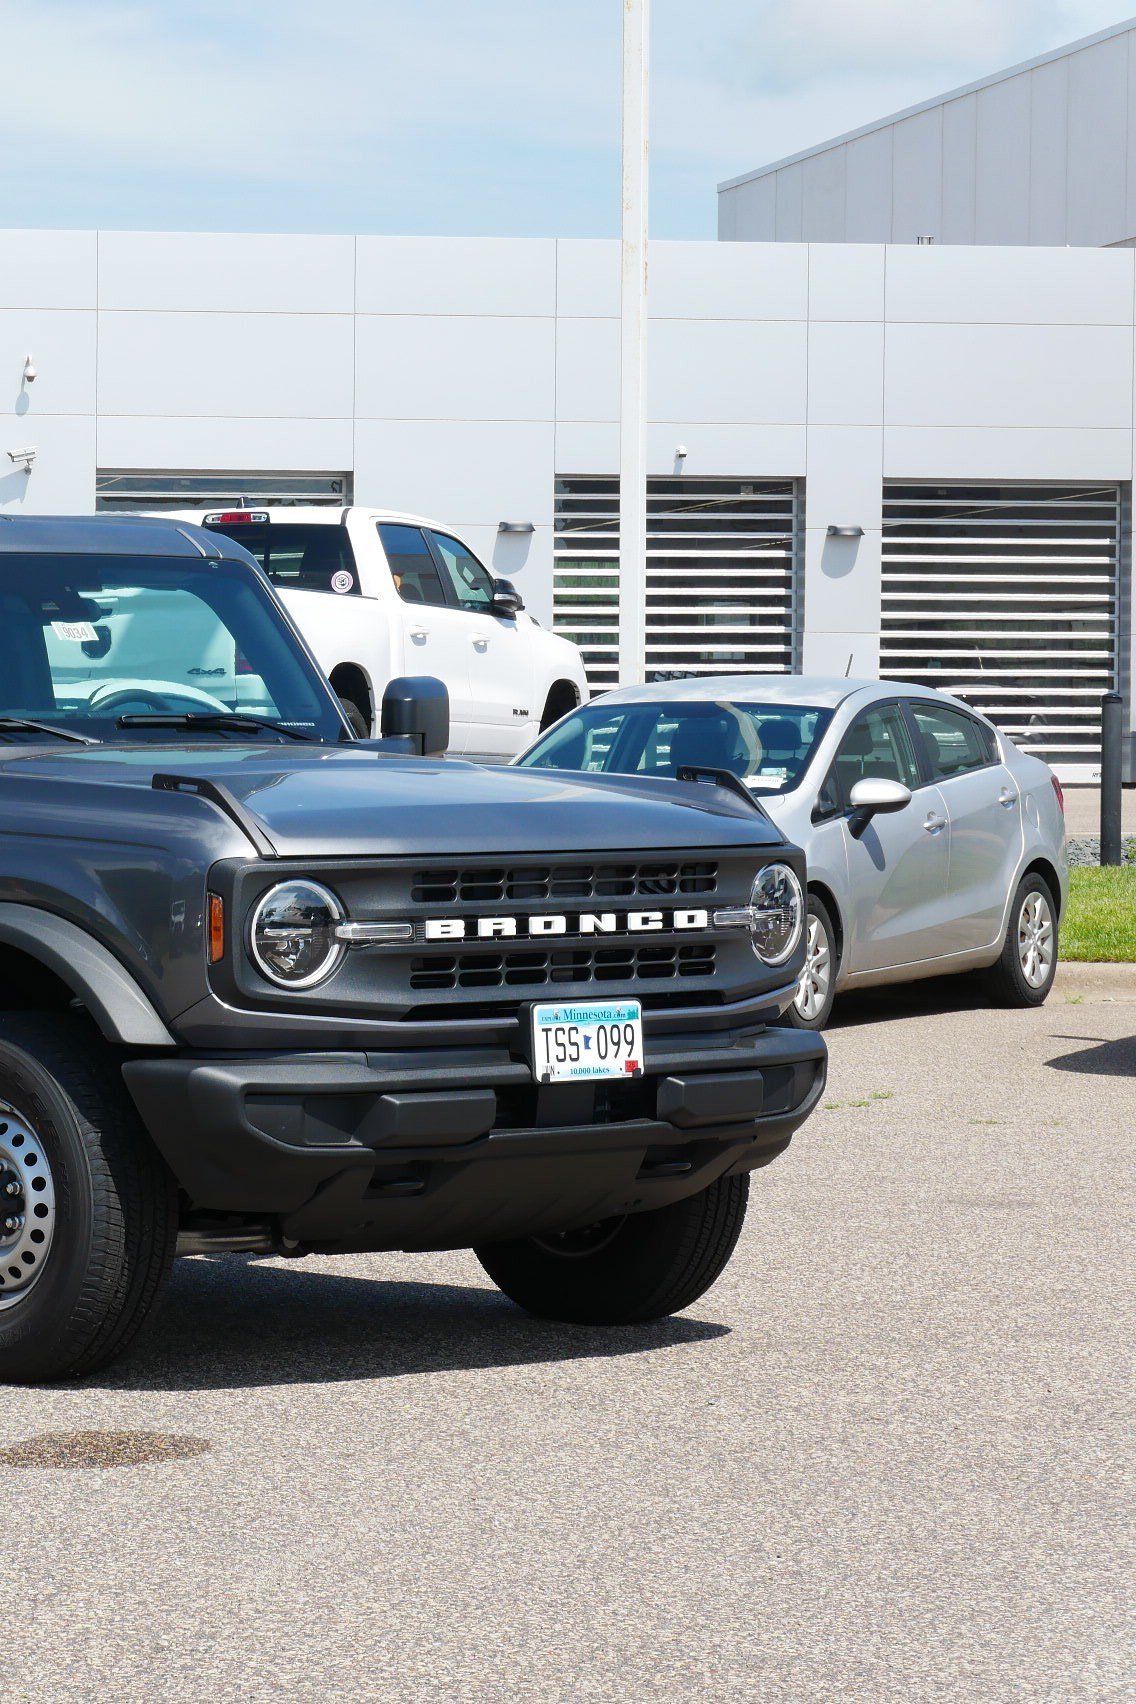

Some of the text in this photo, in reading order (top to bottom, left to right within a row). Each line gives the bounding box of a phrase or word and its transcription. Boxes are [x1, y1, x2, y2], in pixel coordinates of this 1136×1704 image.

[62, 626, 88, 639] 9034
[425, 909, 708, 939] BRONCO
[563, 1007, 612, 1021] Minnesota
[542, 1024, 635, 1064] TSS 099
[592, 1066, 610, 1074] lakes
